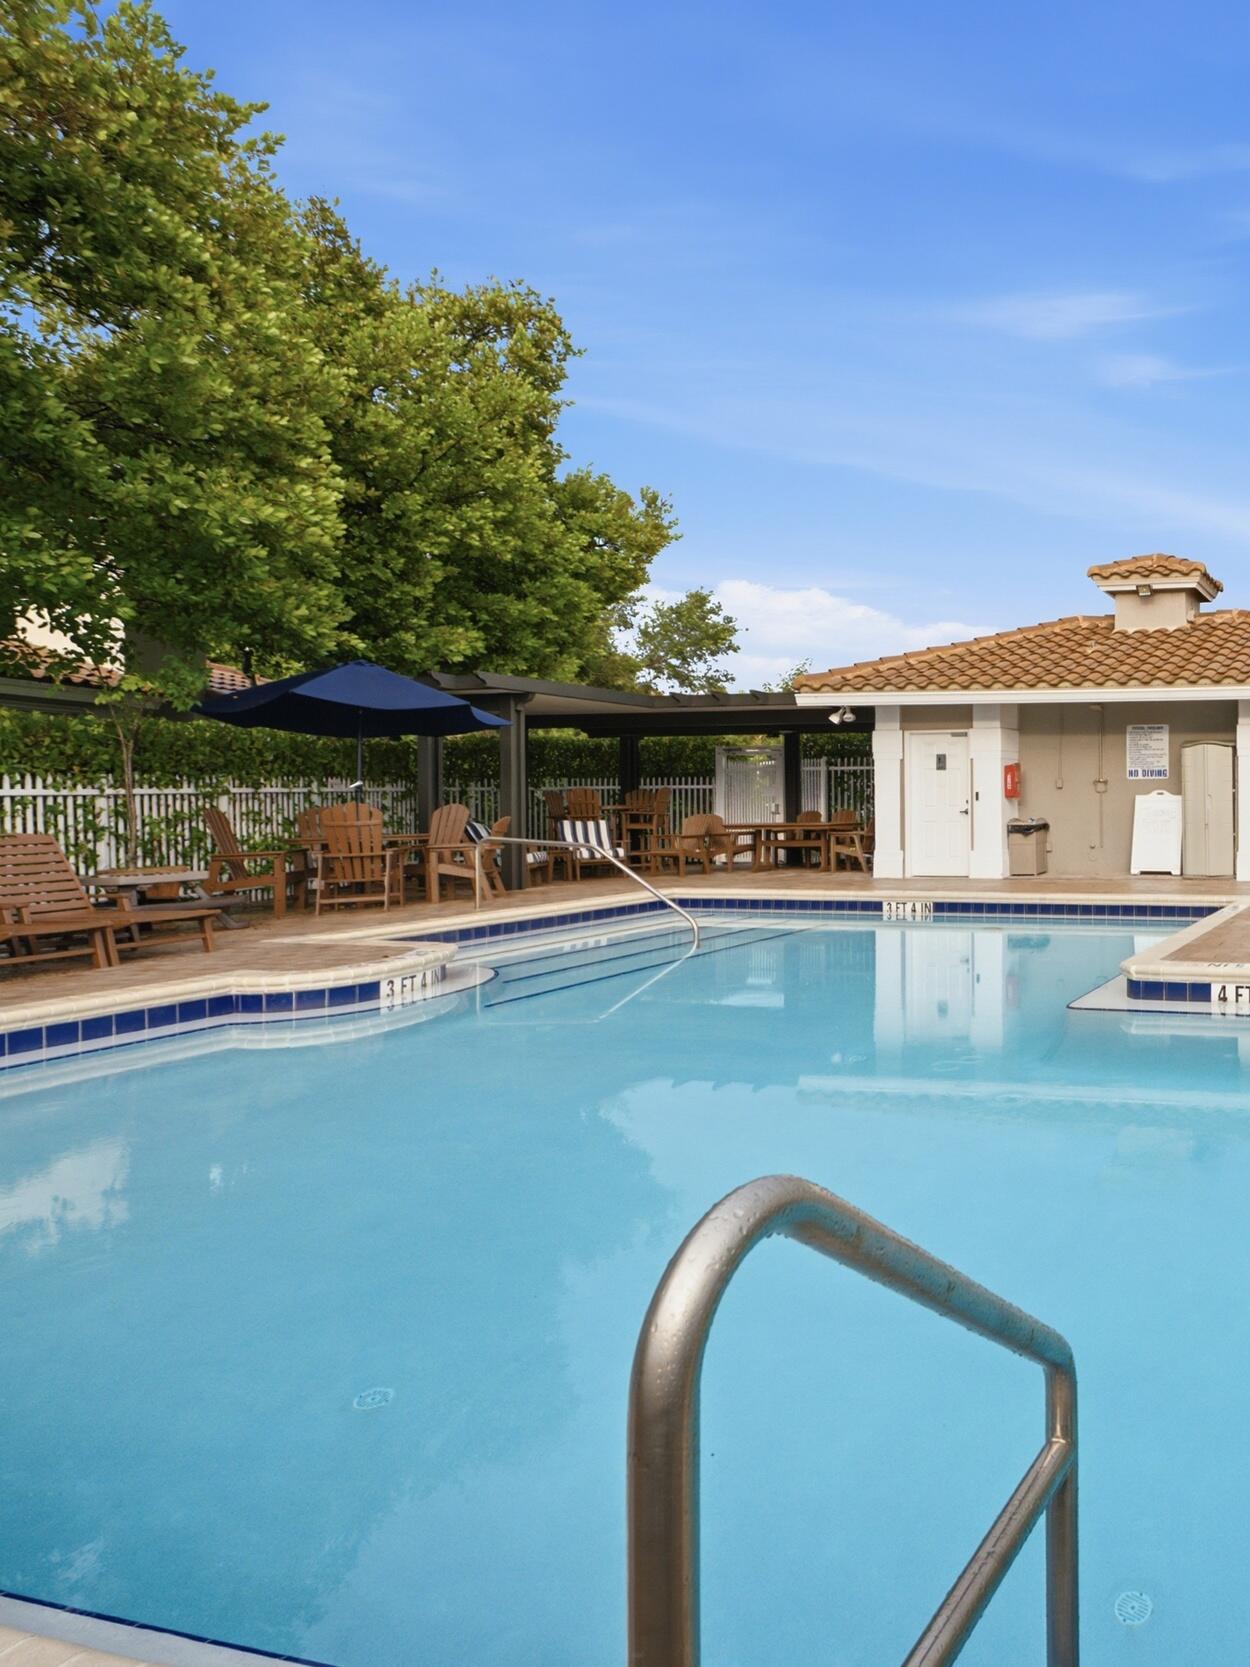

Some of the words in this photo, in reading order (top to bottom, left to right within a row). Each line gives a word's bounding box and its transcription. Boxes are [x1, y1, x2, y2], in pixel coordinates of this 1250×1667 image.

[1128, 769, 1138, 777] NO
[1142, 769, 1167, 777] DIVING
[886, 902, 892, 913] 3
[896, 902, 907, 912] FT
[911, 902, 916, 913] 4
[921, 902, 932, 913] IN
[386, 980, 394, 997] 3
[401, 975, 416, 994] FT
[421, 972, 427, 987] 4
[432, 968, 440, 985] IN
[1218, 985, 1228, 1002] 4
